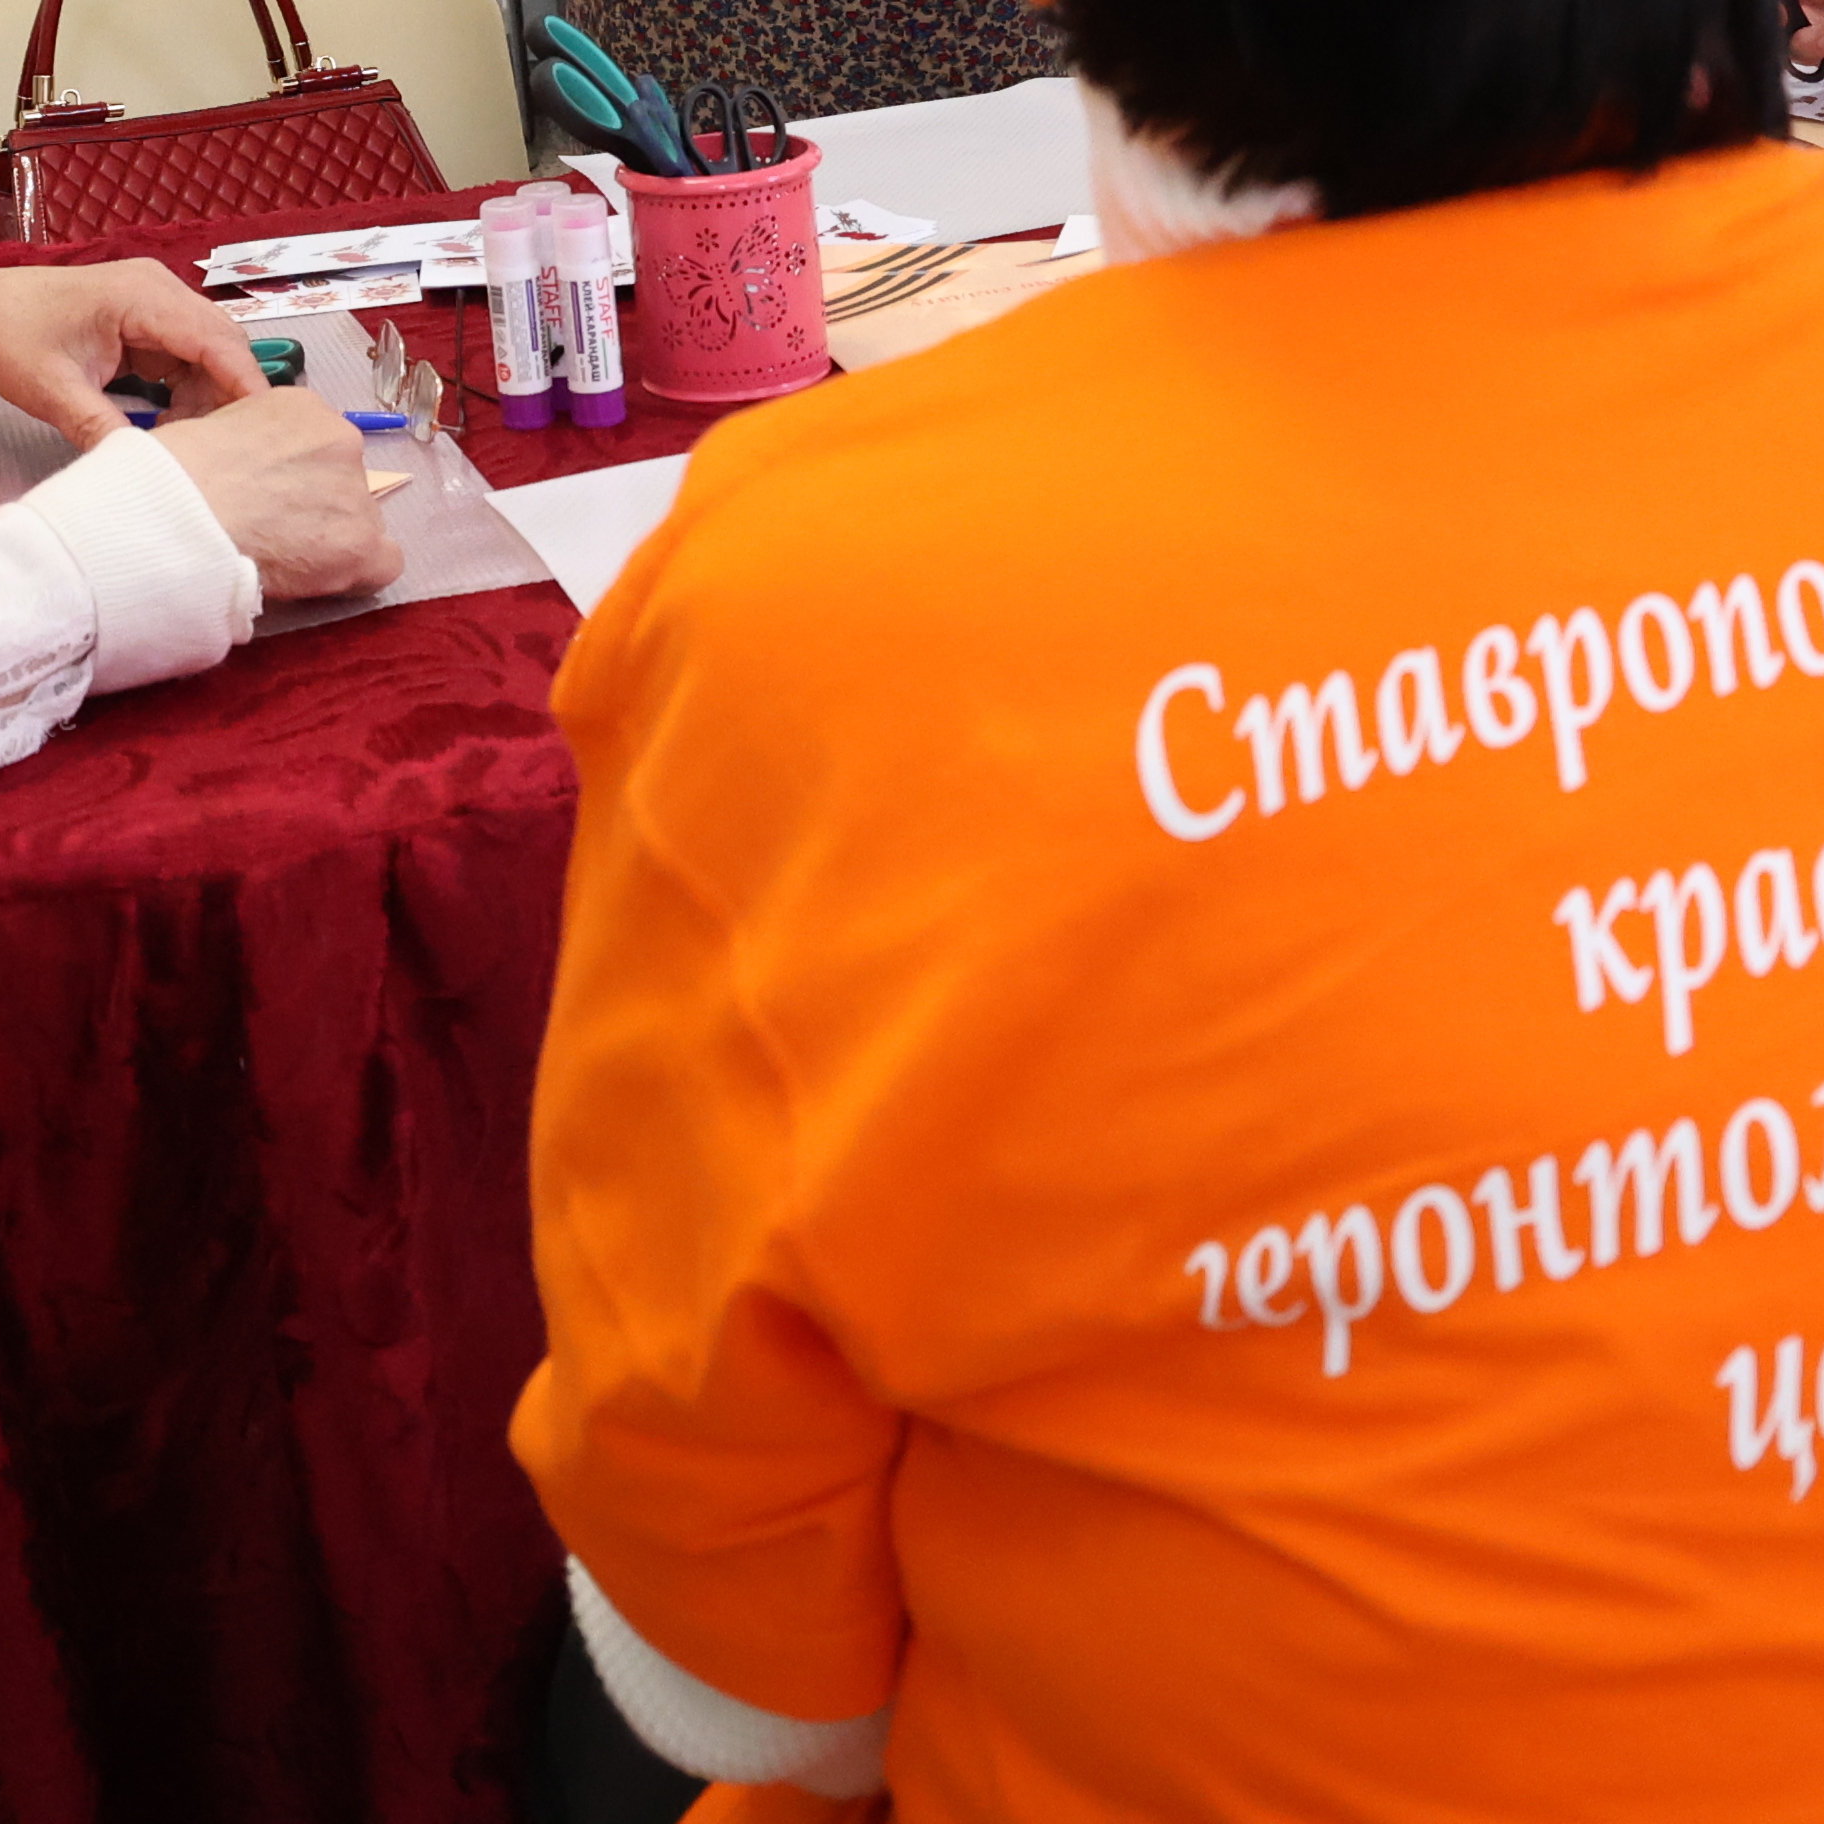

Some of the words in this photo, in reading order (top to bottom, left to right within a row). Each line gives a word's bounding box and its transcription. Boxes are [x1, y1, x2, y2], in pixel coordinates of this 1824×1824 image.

[541, 265, 564, 329] STAFF
[596, 276, 615, 341] STAFF
[581, 280, 601, 383] КЛЕЙ-КАРАНДАШ
